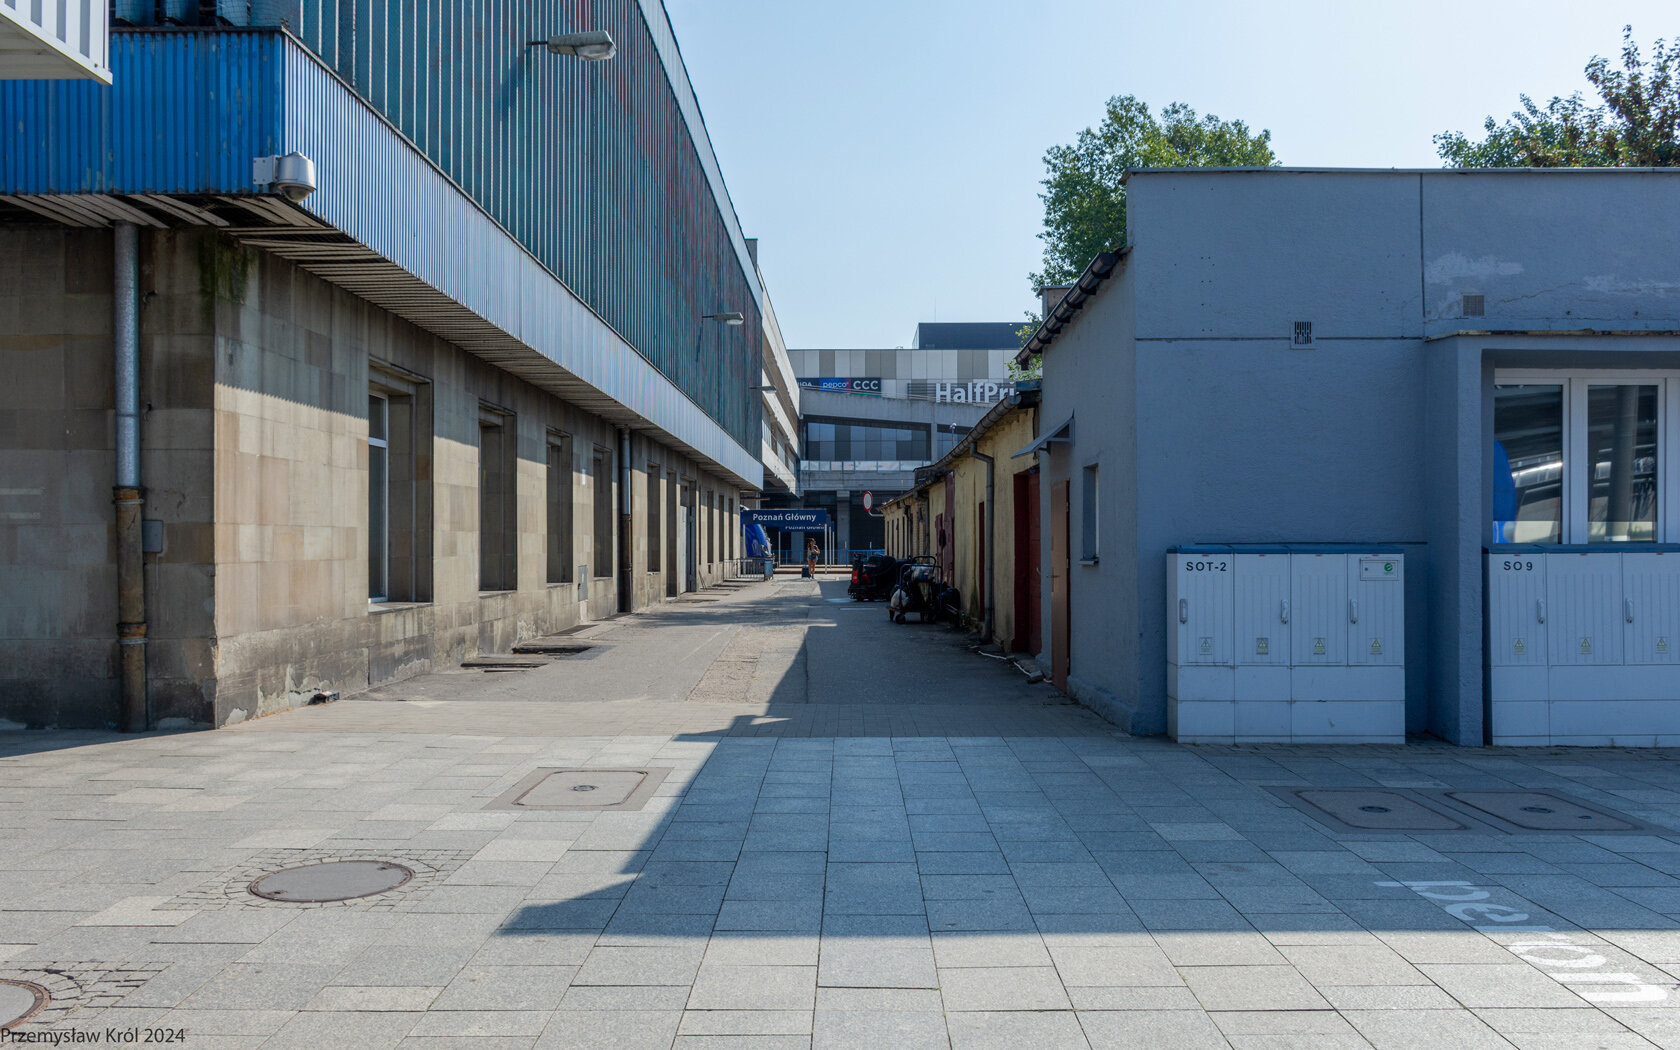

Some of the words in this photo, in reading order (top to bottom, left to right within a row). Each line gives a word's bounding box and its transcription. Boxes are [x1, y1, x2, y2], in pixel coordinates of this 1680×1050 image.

[853, 380, 879, 390] CCC
[935, 381, 1019, 403] HalfPri
[752, 512, 783, 521] Poznań
[785, 512, 817, 522] Główny
[1186, 561, 1227, 571] SOT-2
[1372, 881, 1668, 1000] peron
